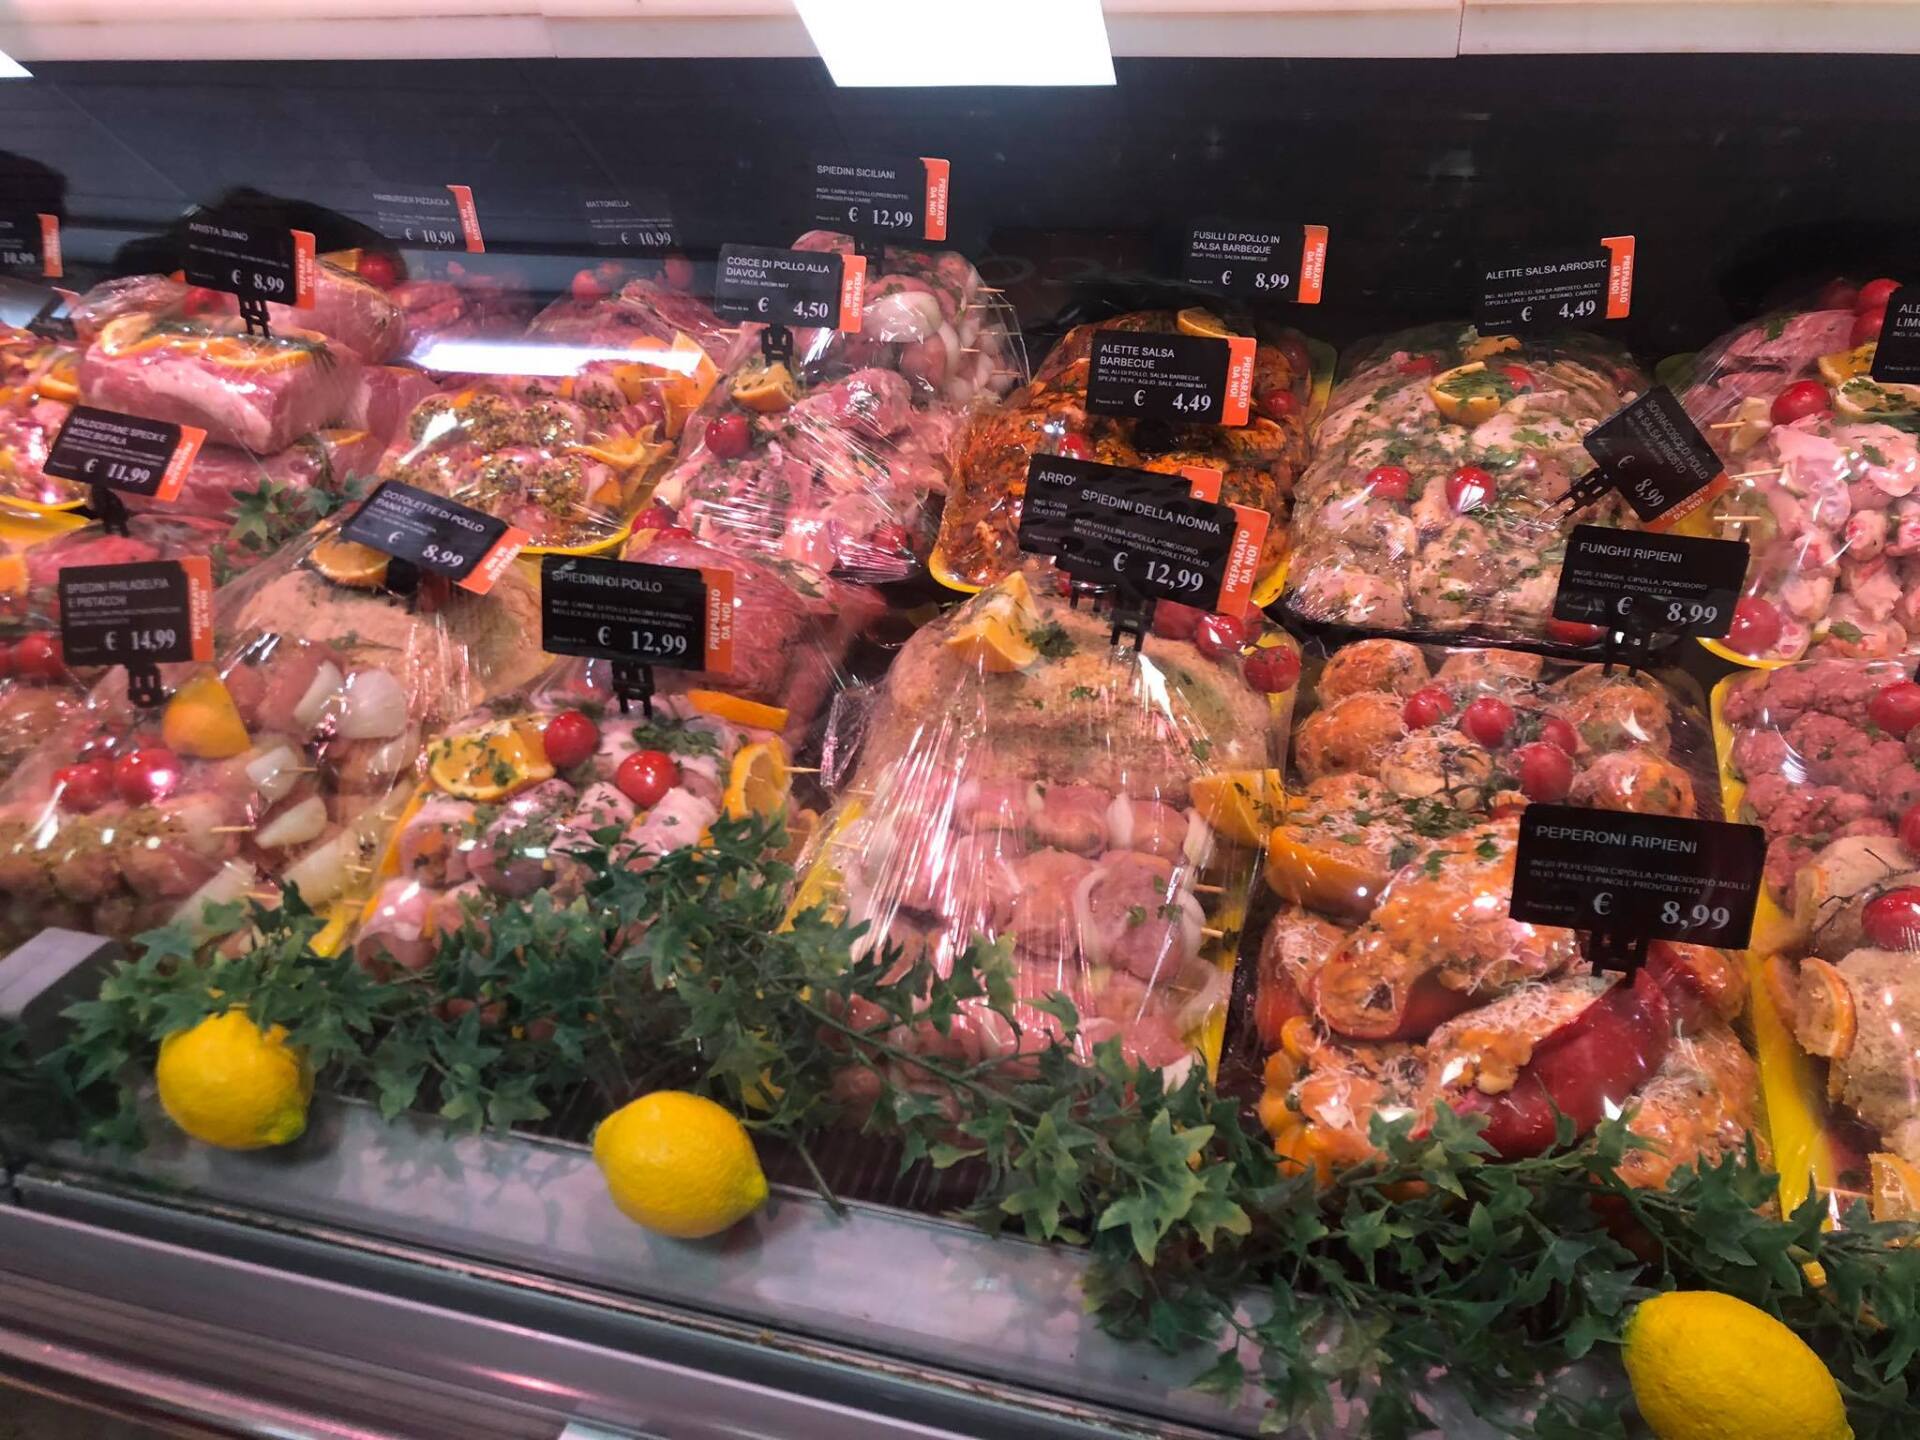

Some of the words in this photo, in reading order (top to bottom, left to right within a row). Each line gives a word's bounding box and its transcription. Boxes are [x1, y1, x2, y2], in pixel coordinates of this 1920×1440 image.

[817, 165, 854, 176] SPIEDINI
[855, 169, 896, 180] SICILIANI
[937, 178, 946, 226] PREPARATO
[848, 206, 858, 222] €
[873, 210, 914, 228] 12,99
[405, 228, 416, 241] €
[423, 230, 456, 245] 10,90
[621, 232, 631, 245] €
[638, 232, 672, 247] 10,99
[1193, 231, 1225, 242] FUSILLI
[1239, 234, 1268, 243] POLLO
[1270, 235, 1280, 243] IN
[1192, 242, 1220, 251] SALSA
[1222, 244, 1271, 254] BARBEQUE
[1307, 252, 1315, 263] DA
[726, 267, 766, 279] DIAVOLA
[727, 256, 759, 267] COSCE
[762, 261, 772, 269] DI
[774, 261, 805, 271] POLLO
[807, 264, 830, 273] ALLA
[1304, 265, 1314, 279] NOI
[1312, 243, 1325, 288] PREPARATO
[1486, 269, 1523, 281] ALETTE
[1525, 265, 1559, 276] SALSA
[1613, 266, 1621, 278] DA
[231, 270, 242, 286] €
[254, 272, 286, 293] 8,99
[1222, 270, 1232, 286] €
[1255, 272, 1289, 290] 8,99
[1610, 280, 1620, 295] NOI
[1620, 255, 1632, 304] PREPARATO
[758, 297, 770, 313] €
[793, 301, 829, 319] 4,50
[1521, 306, 1533, 322] €
[1559, 300, 1597, 320] 4,49
[1899, 303, 1920, 314] ALE
[1101, 344, 1139, 355] ALETTE
[1141, 347, 1174, 358] SALSA
[1100, 356, 1155, 369] BARBECUE
[1232, 366, 1242, 379] DA
[1229, 381, 1241, 398] NOI
[1238, 357, 1252, 409] PREPARATO
[1134, 389, 1146, 406] €
[1172, 393, 1211, 414] 4,49
[84, 458, 99, 473] €
[107, 463, 151, 484] 11,99
[1687, 454, 1710, 481] POLLO
[1038, 471, 1077, 487] ARRO
[1634, 478, 1665, 508] 8,99
[375, 498, 415, 517] PANATE
[382, 490, 441, 515] COTOLETTE
[438, 510, 452, 520] DI
[451, 514, 485, 533] POLLO
[1048, 501, 1068, 509] CARN
[1081, 489, 1132, 512] SPIEDINI
[1135, 502, 1173, 522] DELLA
[1176, 513, 1221, 535] NONNA
[388, 531, 404, 545] €
[422, 544, 464, 567] 8,99
[1243, 545, 1258, 569] NOI
[1580, 542, 1630, 558] FUNGHI
[1633, 548, 1682, 563] RIPIENI
[1113, 552, 1128, 572] €
[1145, 560, 1204, 591] 12,99
[1225, 529, 1250, 593] PREPARATO
[552, 571, 605, 587] SPIEDINI
[623, 579, 663, 593] POLLO
[1240, 569, 1251, 584] DA
[711, 588, 721, 650] PREPARATO
[1616, 596, 1633, 615] €
[1667, 602, 1719, 625] 8,99
[105, 631, 118, 651] €
[131, 629, 177, 653] 14,99
[597, 626, 612, 646] €
[631, 630, 687, 655] 12,99
[1536, 825, 1627, 847] PEPERONI
[1630, 836, 1699, 855] RIPIENI
[1592, 891, 1614, 916] €
[1660, 900, 1731, 930] 8,99
